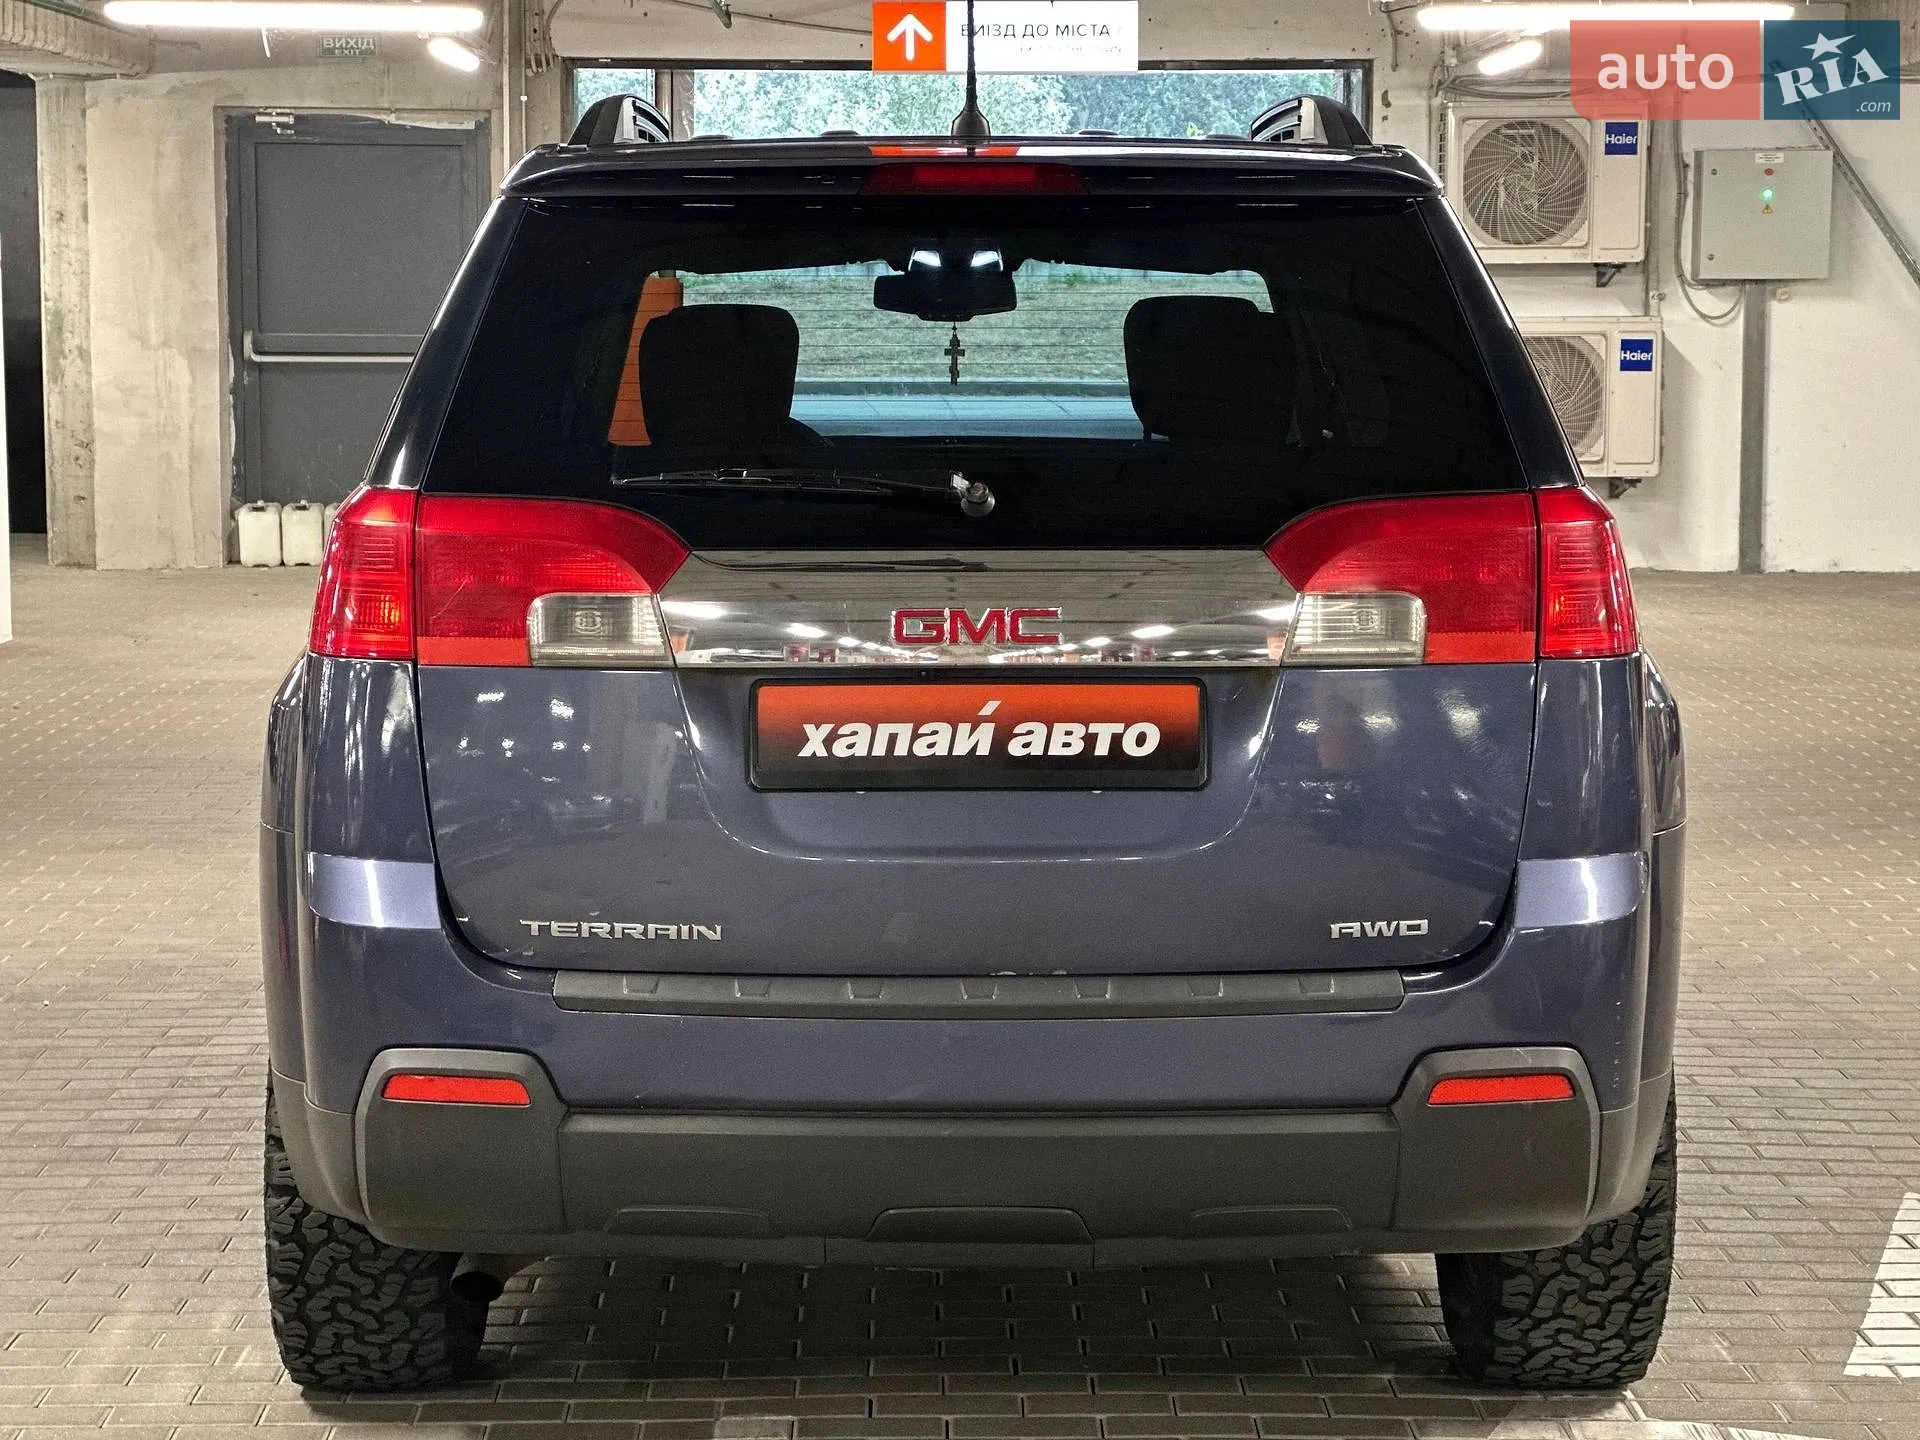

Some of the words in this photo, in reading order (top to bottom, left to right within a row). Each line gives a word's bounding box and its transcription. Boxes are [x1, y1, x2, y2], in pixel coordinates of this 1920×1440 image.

[1022, 24, 1049, 38] ДО
[1056, 24, 1110, 36] МІСТА
[323, 37, 375, 50] ВИХІД
[1605, 133, 1638, 145] Haier
[1621, 350, 1653, 361] Haier
[890, 607, 1063, 645] GMC
[1007, 721, 1161, 757] авто
[519, 919, 723, 941] TERRAIN
[1330, 919, 1429, 939] AWD
